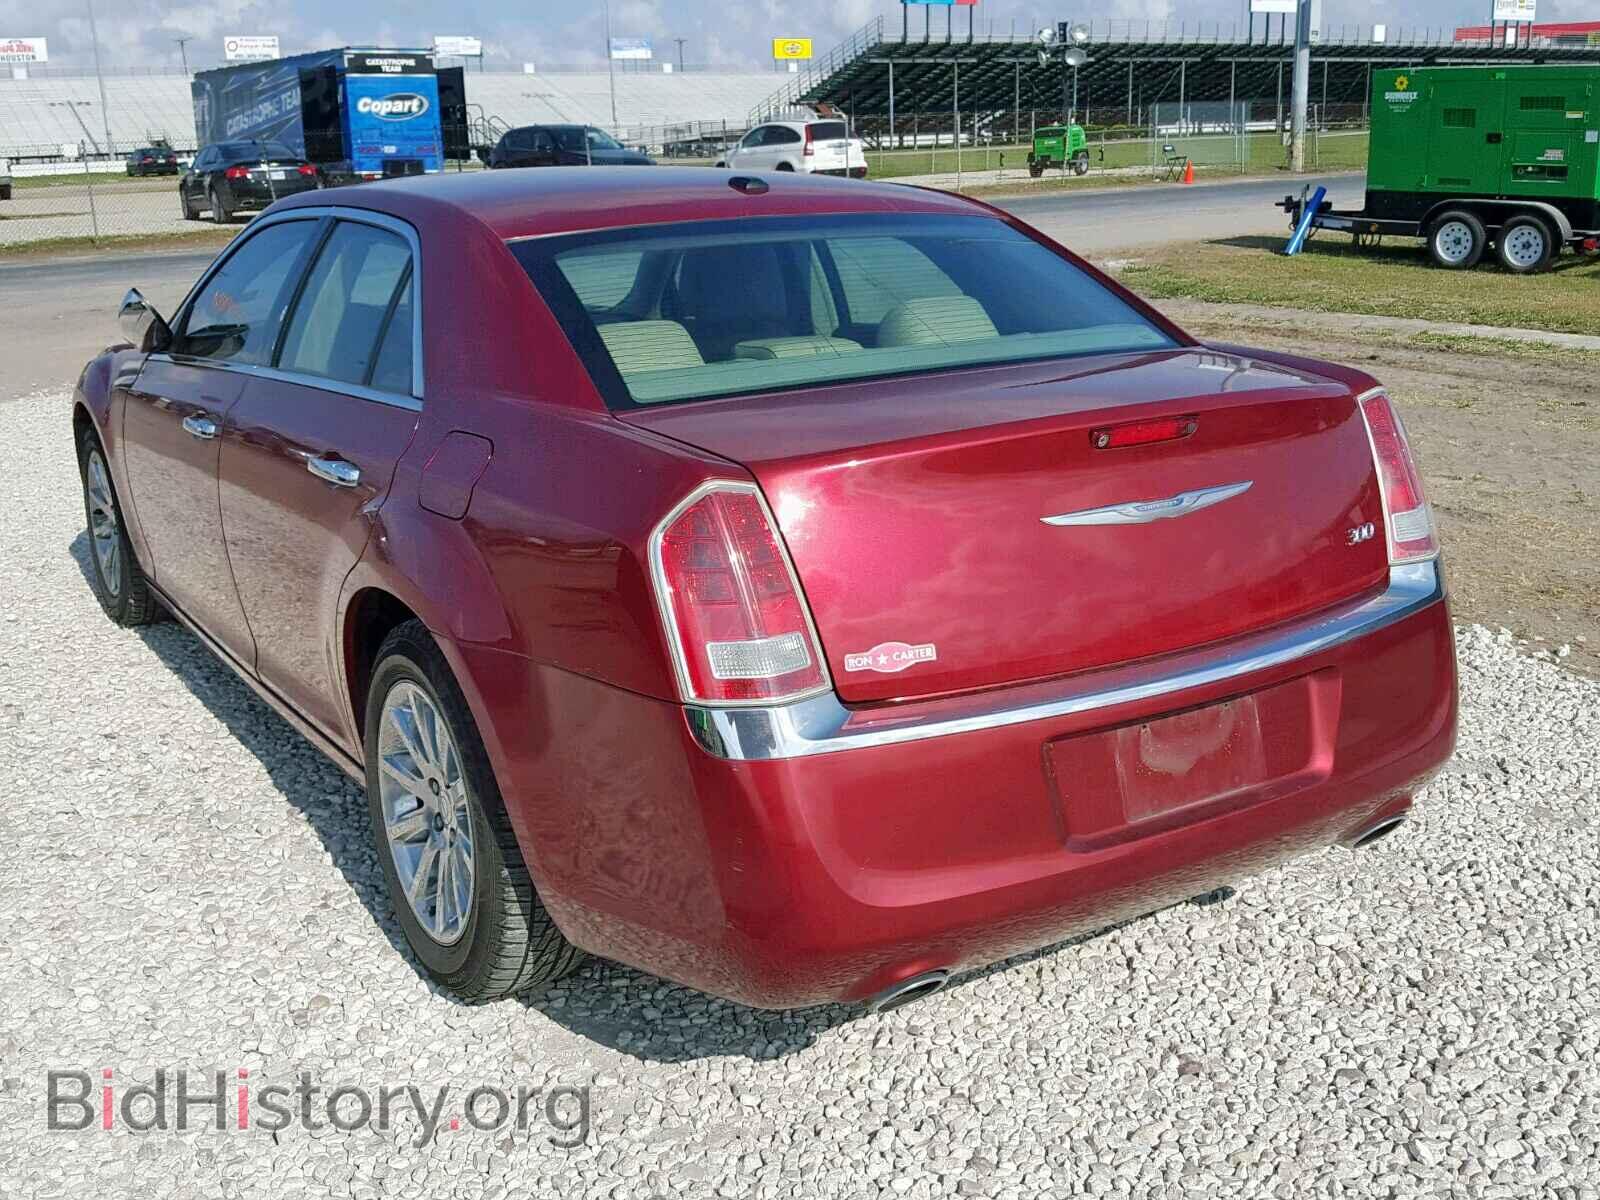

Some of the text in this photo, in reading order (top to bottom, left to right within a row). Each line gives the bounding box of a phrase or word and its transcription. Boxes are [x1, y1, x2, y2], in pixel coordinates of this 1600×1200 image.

[365, 58, 416, 66] CATASTROPHE
[357, 96, 420, 116] Copart
[1345, 522, 1375, 545] 300
[847, 647, 932, 669] RON CARTER
